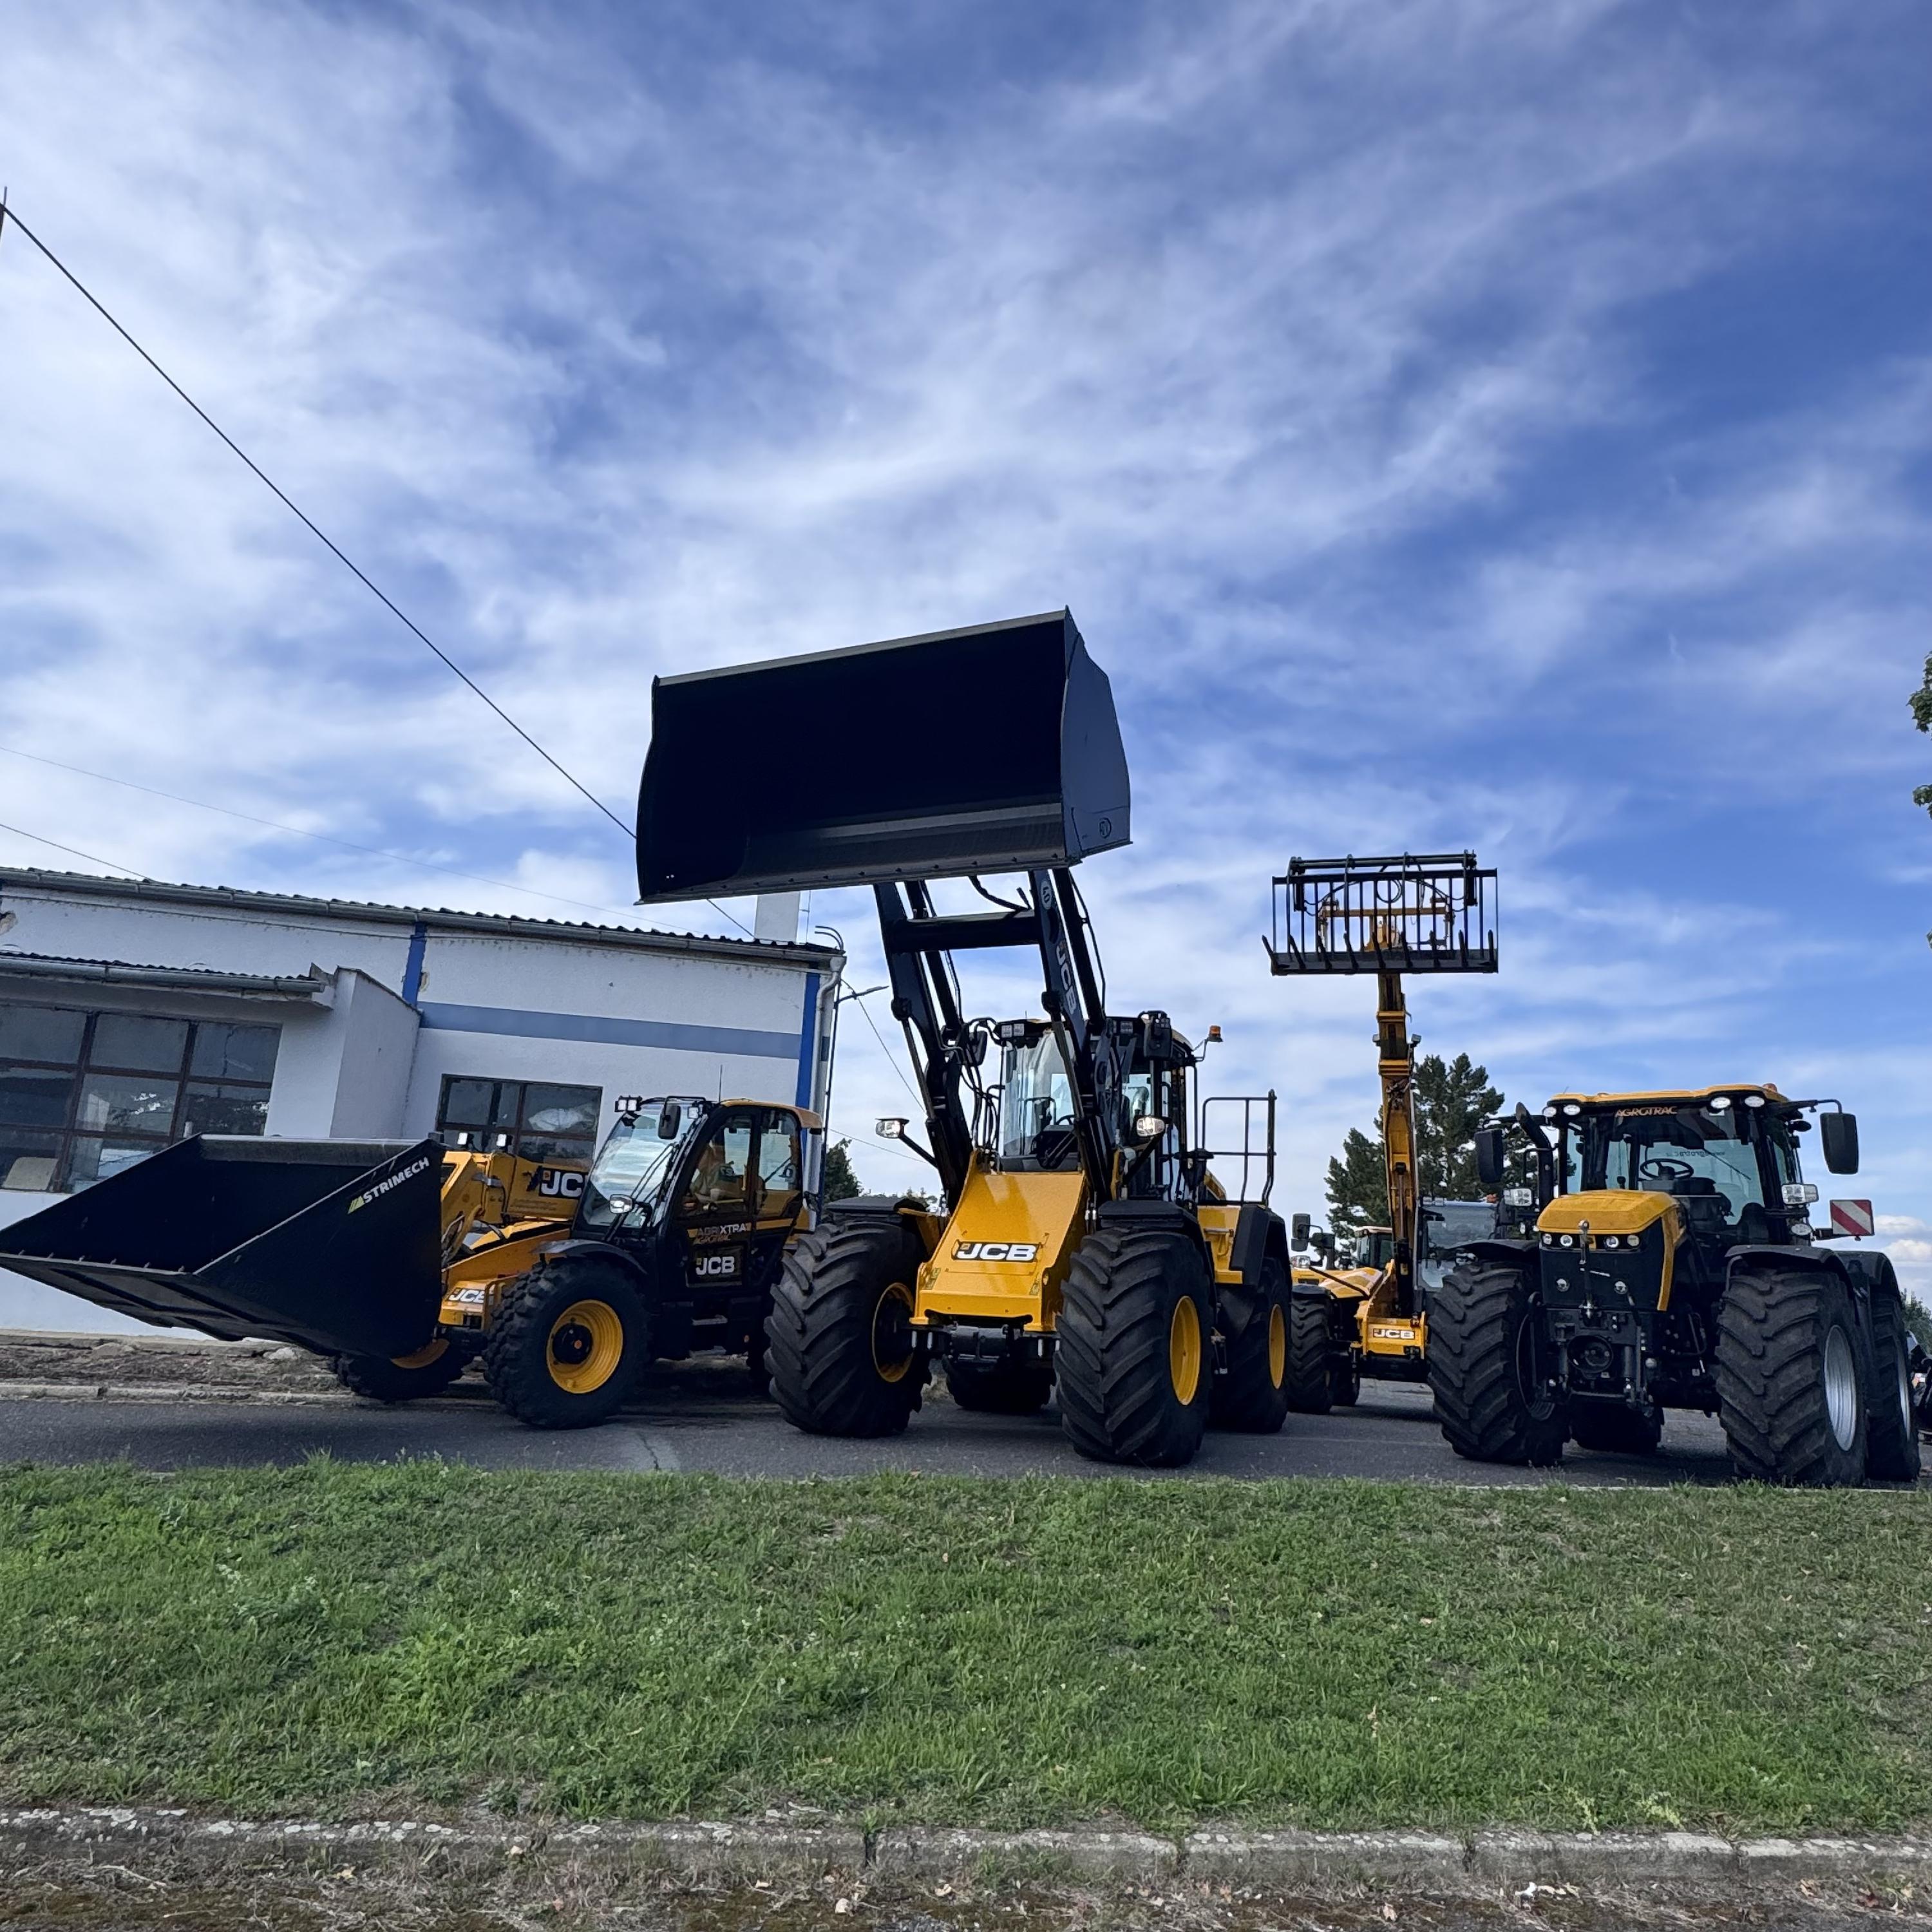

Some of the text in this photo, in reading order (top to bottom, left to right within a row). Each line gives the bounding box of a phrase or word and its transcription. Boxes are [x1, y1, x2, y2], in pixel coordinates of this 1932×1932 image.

[1615, 1106, 1678, 1117] AGROTRAC
[363, 1156, 430, 1204] STRIMECH
[541, 1170, 587, 1198] JC
[956, 1243, 1036, 1260] JCB
[696, 1256, 735, 1275] JCB
[1374, 1329, 1414, 1339] JCB
